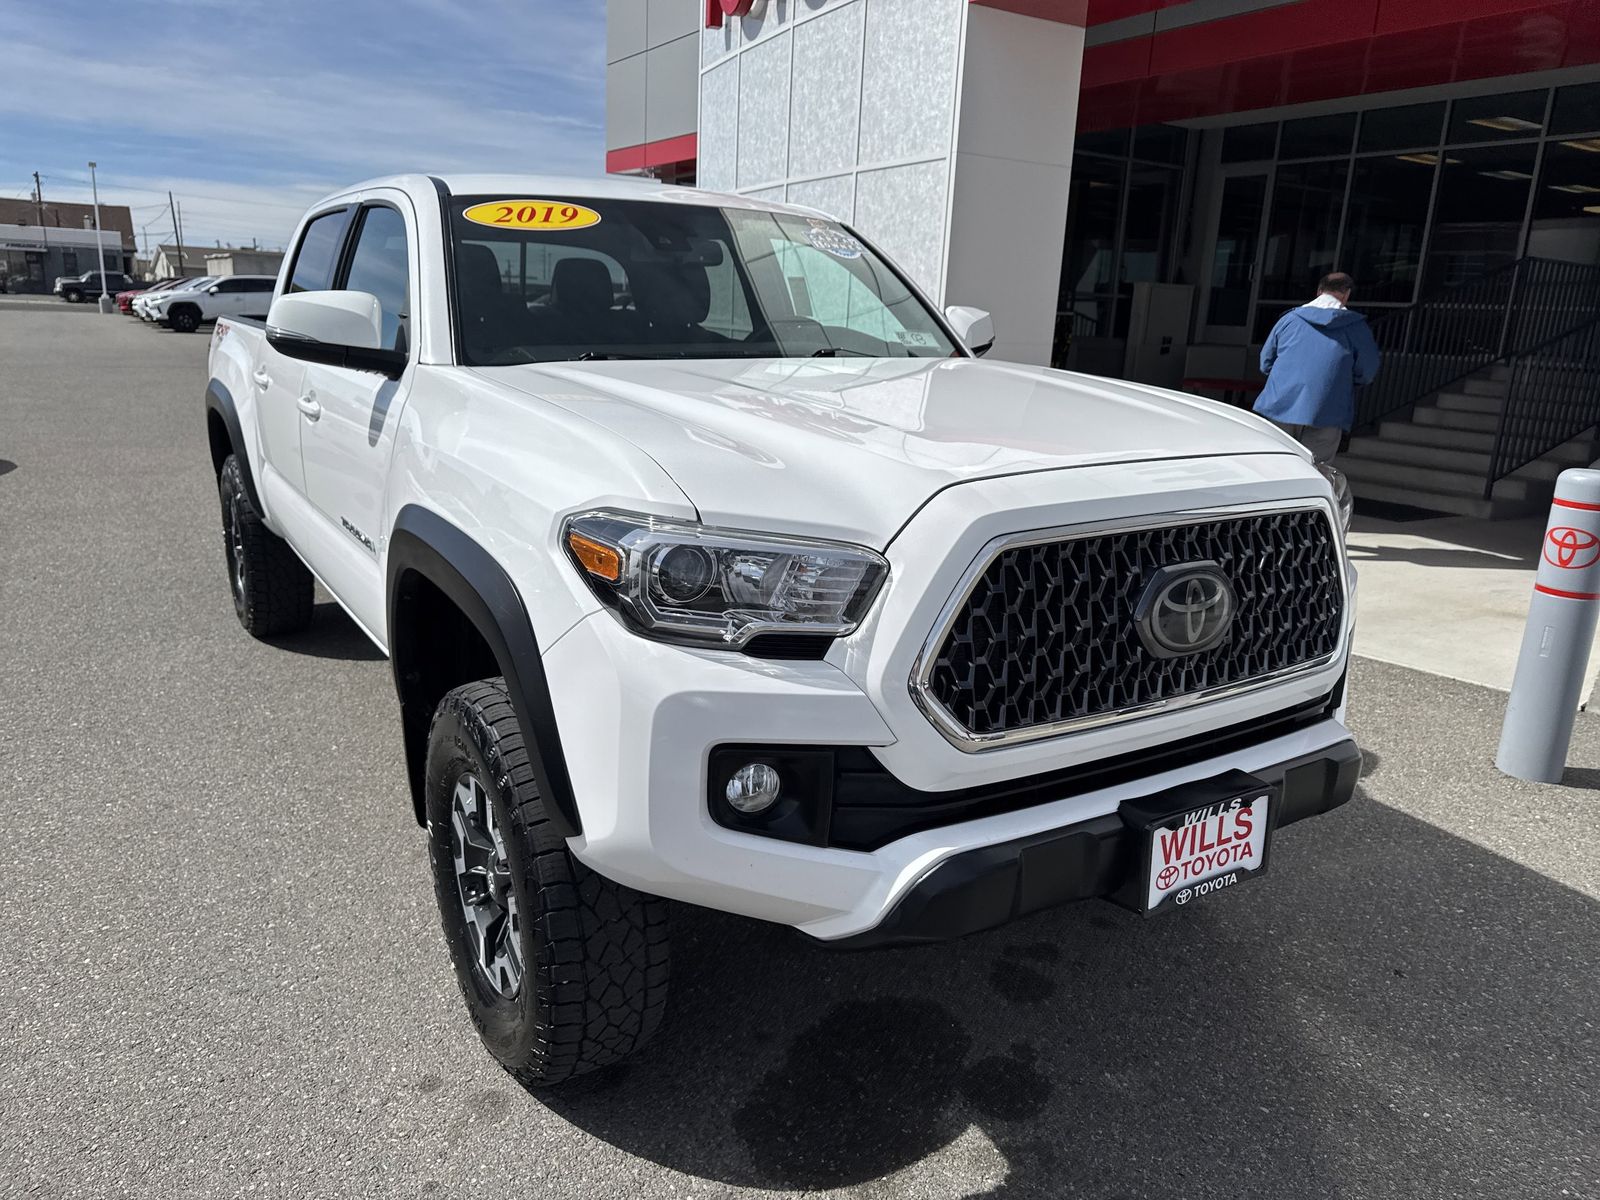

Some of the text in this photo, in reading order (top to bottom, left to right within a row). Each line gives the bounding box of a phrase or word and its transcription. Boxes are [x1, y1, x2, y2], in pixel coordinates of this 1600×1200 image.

[493, 206, 579, 224] 2019
[1184, 797, 1242, 827] WILLS
[1160, 806, 1254, 866] WILLS
[1181, 841, 1254, 880] TOYOTA
[1193, 872, 1238, 898] TOYOTA
